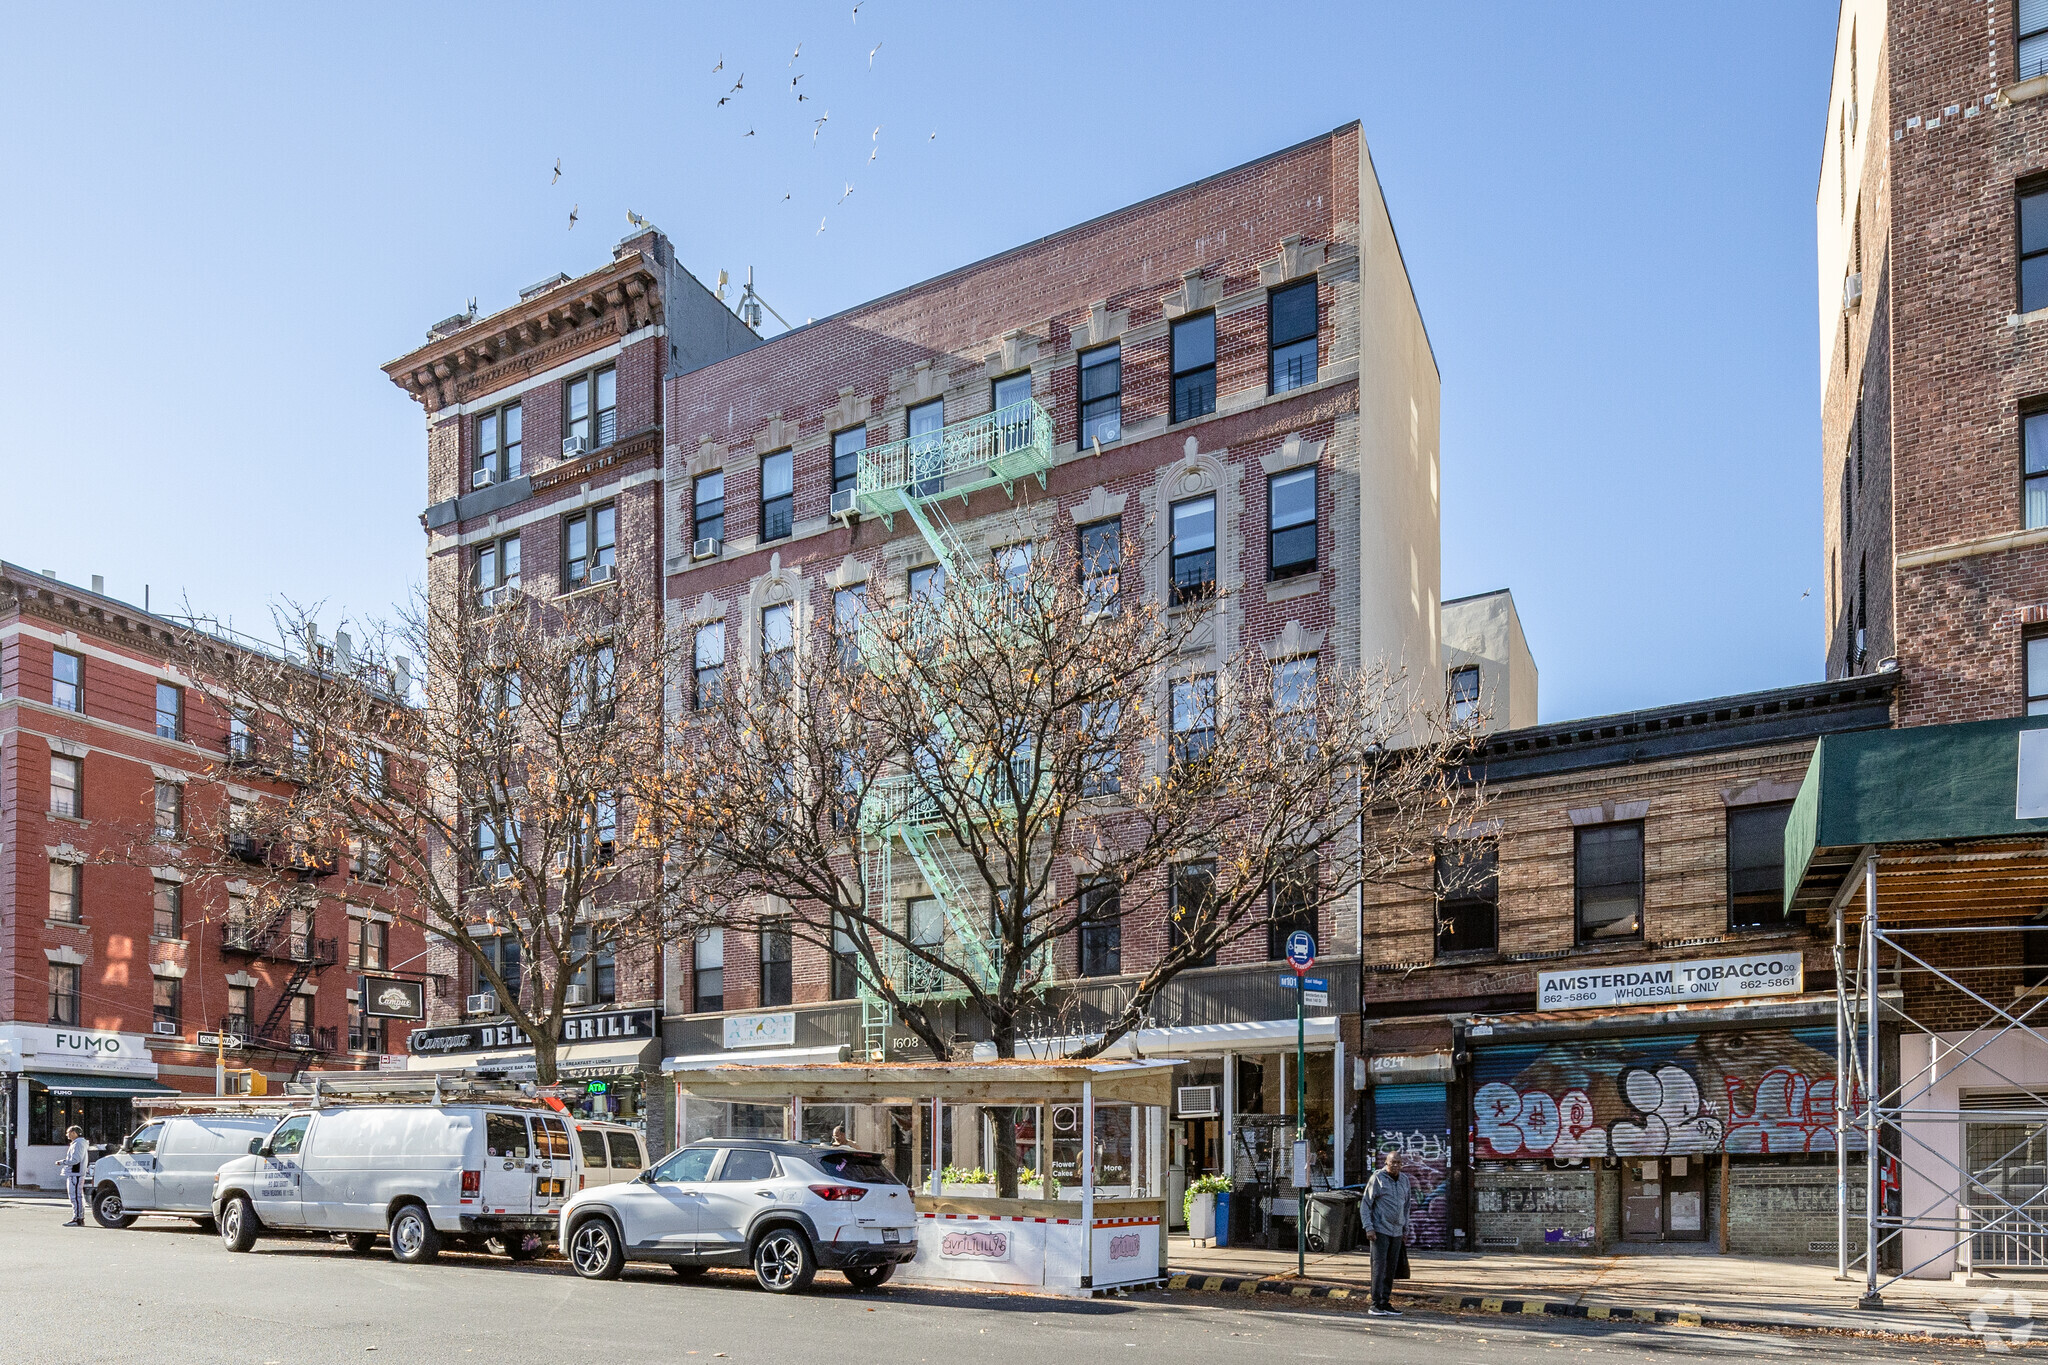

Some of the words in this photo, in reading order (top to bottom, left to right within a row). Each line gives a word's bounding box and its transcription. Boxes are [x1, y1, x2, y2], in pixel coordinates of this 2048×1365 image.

[1281, 977, 1297, 987] M101
[1544, 970, 1673, 992] AMSTERDAM
[1683, 961, 1783, 982] TOBACCO
[1740, 977, 1796, 989] 862-5861
[1616, 984, 1685, 999] WHOLESALE
[1690, 981, 1719, 994] ONLY
[378, 994, 412, 1008] Campus
[1543, 992, 1597, 1004] 862-5860
[201, 1036, 216, 1044] ONE
[413, 1030, 473, 1053] Campus
[564, 1015, 638, 1040] GRILL
[56, 1033, 120, 1053] FUMO
[893, 1036, 919, 1049] 1608
[1374, 1056, 1406, 1071] 1614
[587, 1082, 607, 1093] ATM
